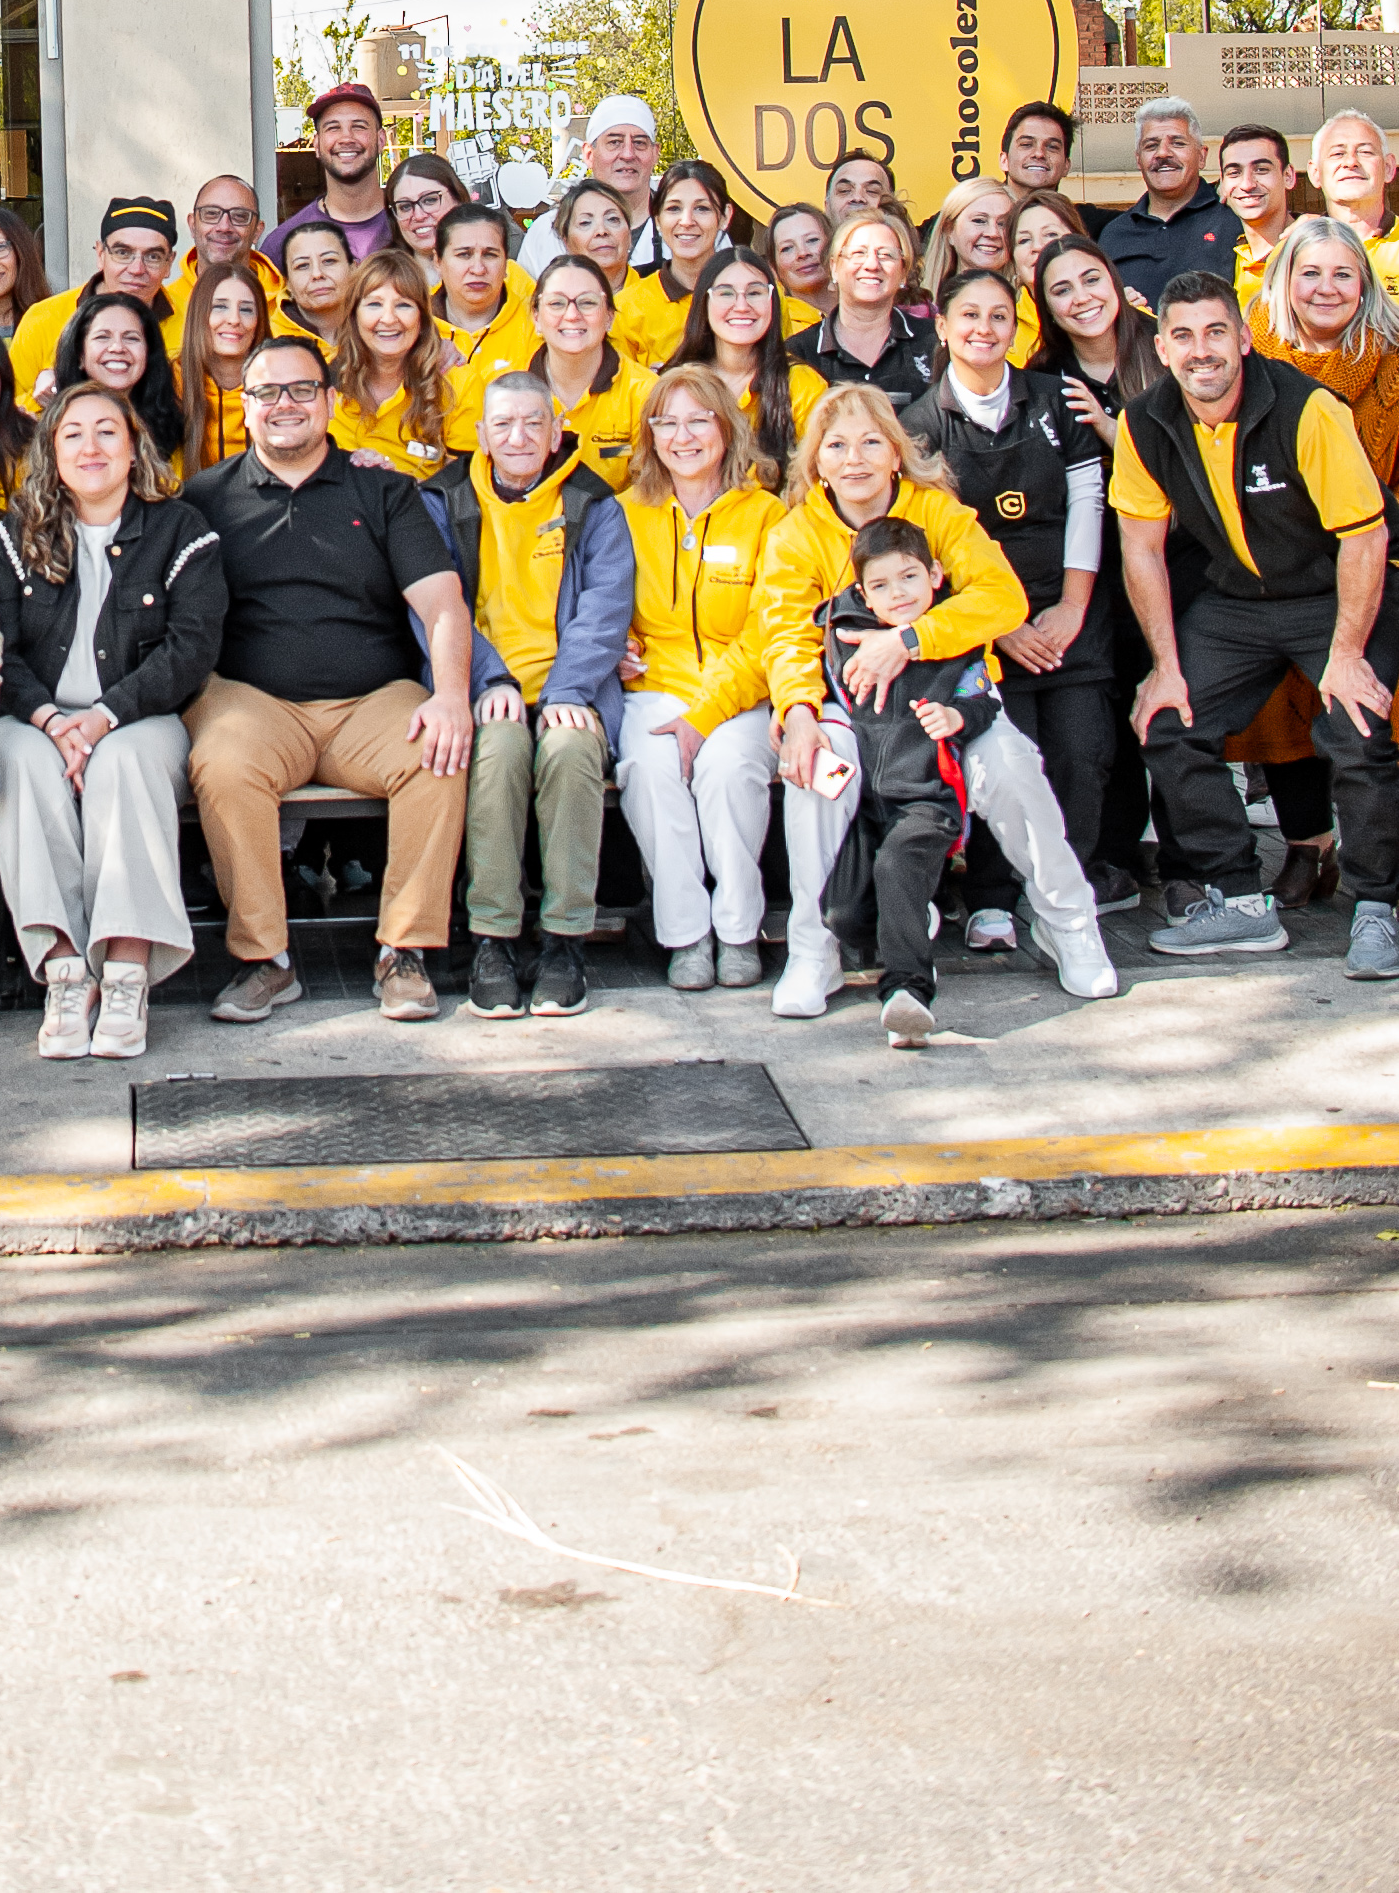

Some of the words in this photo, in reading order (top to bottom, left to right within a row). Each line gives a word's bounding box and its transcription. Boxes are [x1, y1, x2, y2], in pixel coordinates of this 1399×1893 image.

[398, 43, 421, 60] 11
[430, 45, 454, 58] DE
[782, 16, 865, 83] LA
[455, 60, 495, 89] DÍA
[500, 62, 546, 88] DEL
[754, 100, 895, 171] DOS
